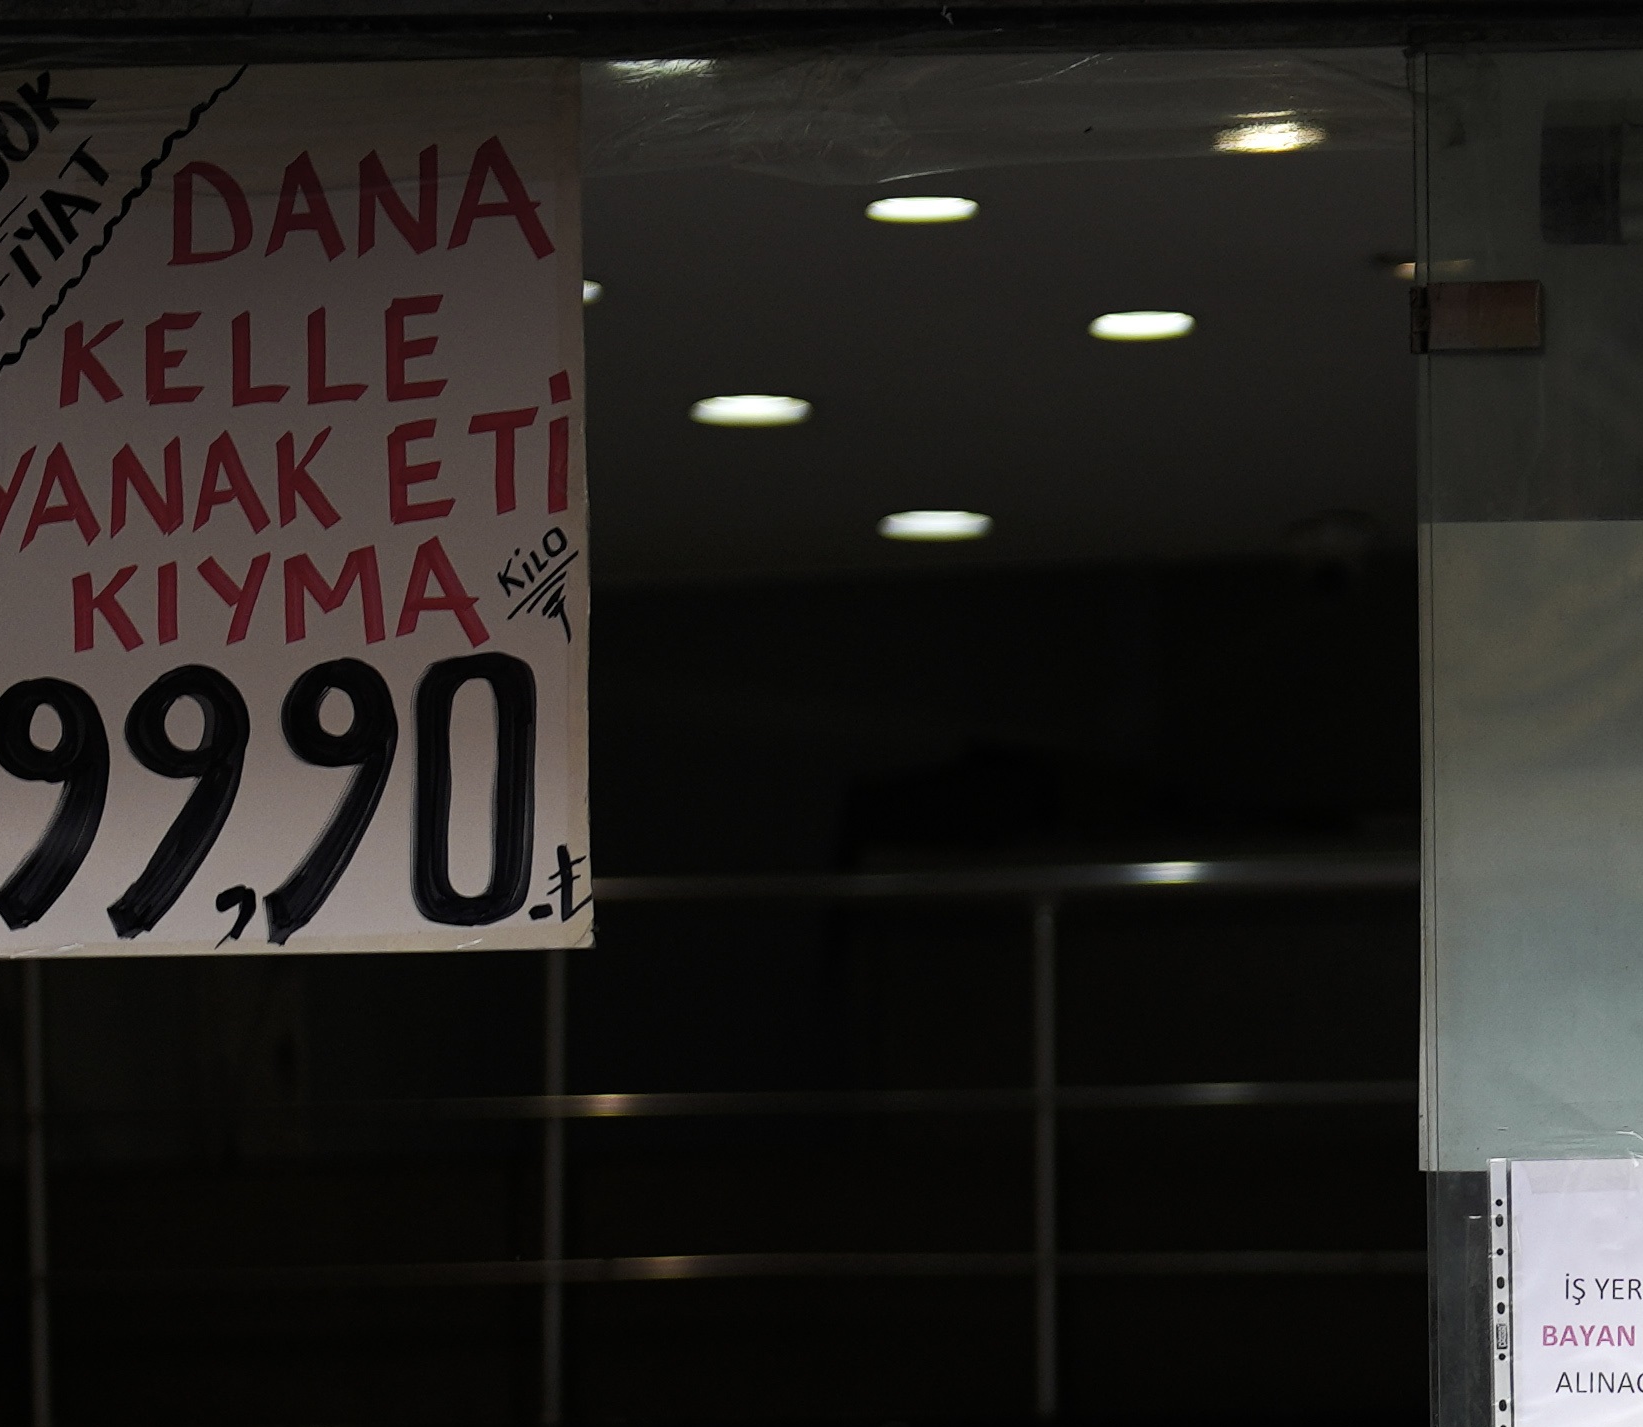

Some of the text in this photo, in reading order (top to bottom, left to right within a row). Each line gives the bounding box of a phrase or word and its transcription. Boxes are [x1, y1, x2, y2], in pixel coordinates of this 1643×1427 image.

[168, 135, 554, 266] DANA
[58, 293, 448, 409] KELLE
[386, 370, 572, 526] ETİ
[71, 535, 490, 653] KIYMA
[496, 526, 569, 599] KİLO
[1542, 1324, 1636, 1347] BAYAN
[1565, 1273, 1587, 1306] İŞ
